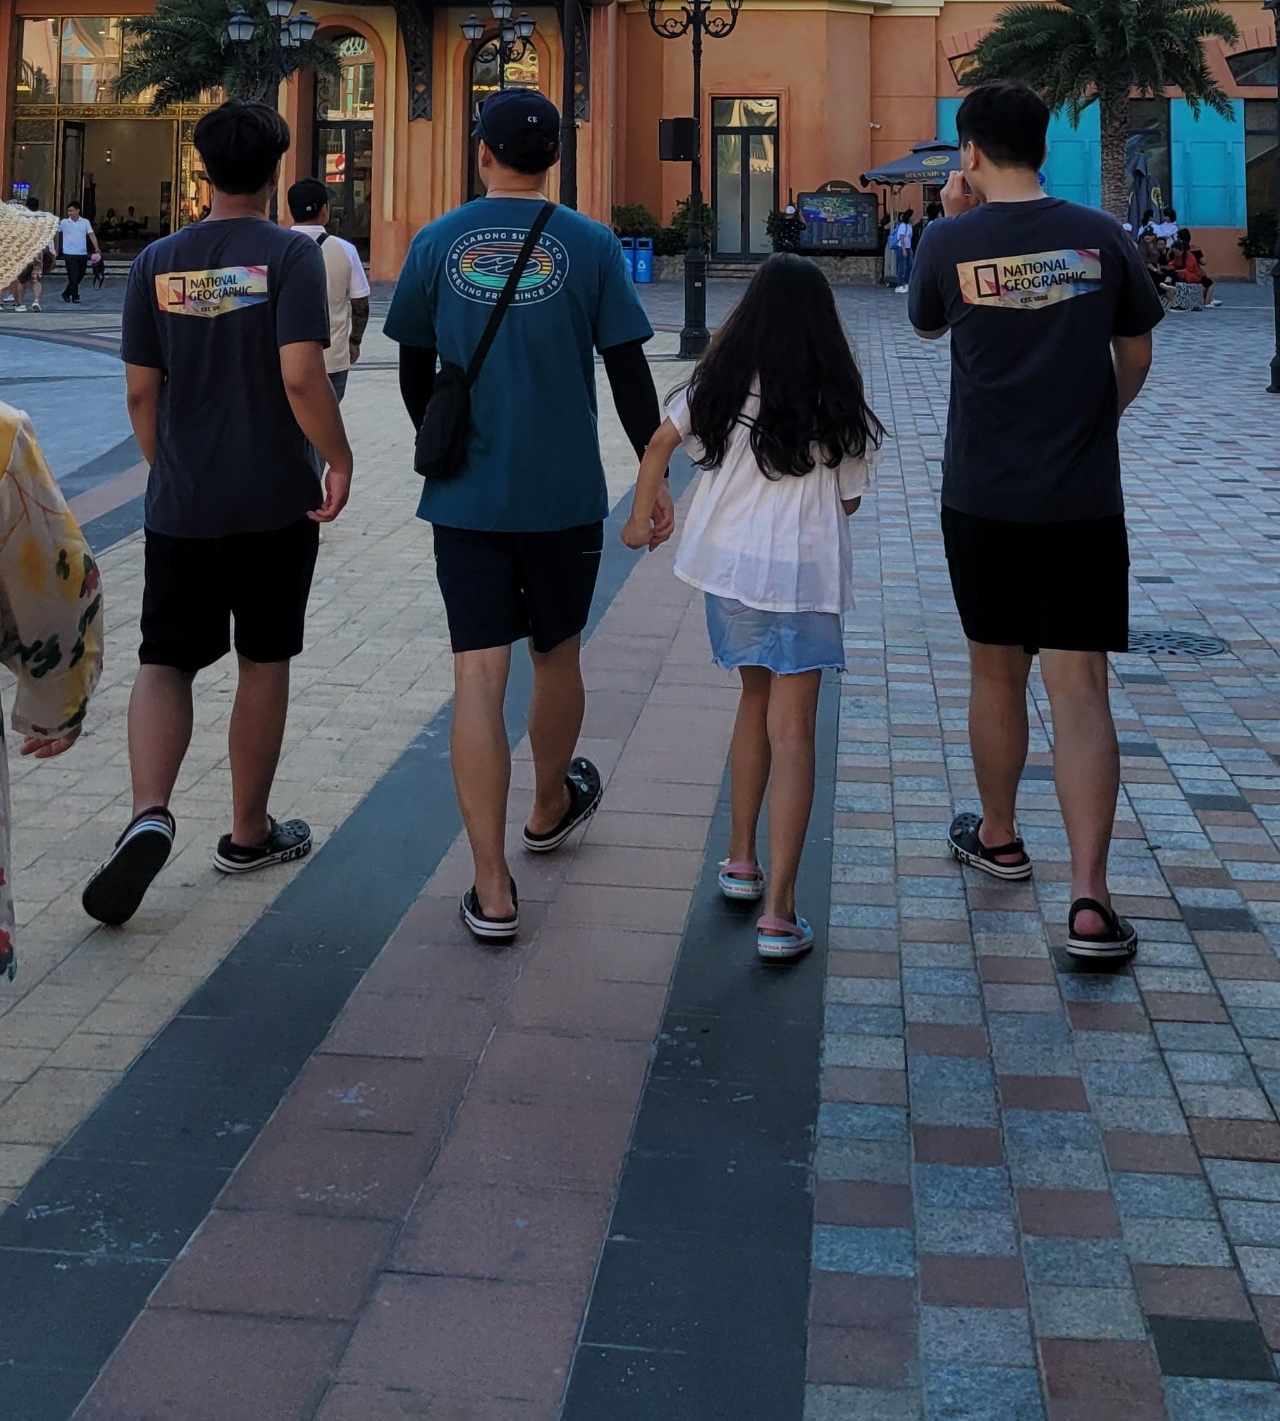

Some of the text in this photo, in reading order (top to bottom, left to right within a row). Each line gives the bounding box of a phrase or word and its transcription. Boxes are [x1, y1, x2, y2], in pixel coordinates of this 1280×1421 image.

[452, 233, 507, 260] BILLABONG
[511, 233, 551, 246] SULY
[1003, 258, 1070, 278] NATIONAL
[451, 267, 481, 297] FEELING
[514, 288, 545, 301] SINCE
[1004, 271, 1087, 292] GEOGRAPHIC
[1020, 296, 1033, 304] EST.
